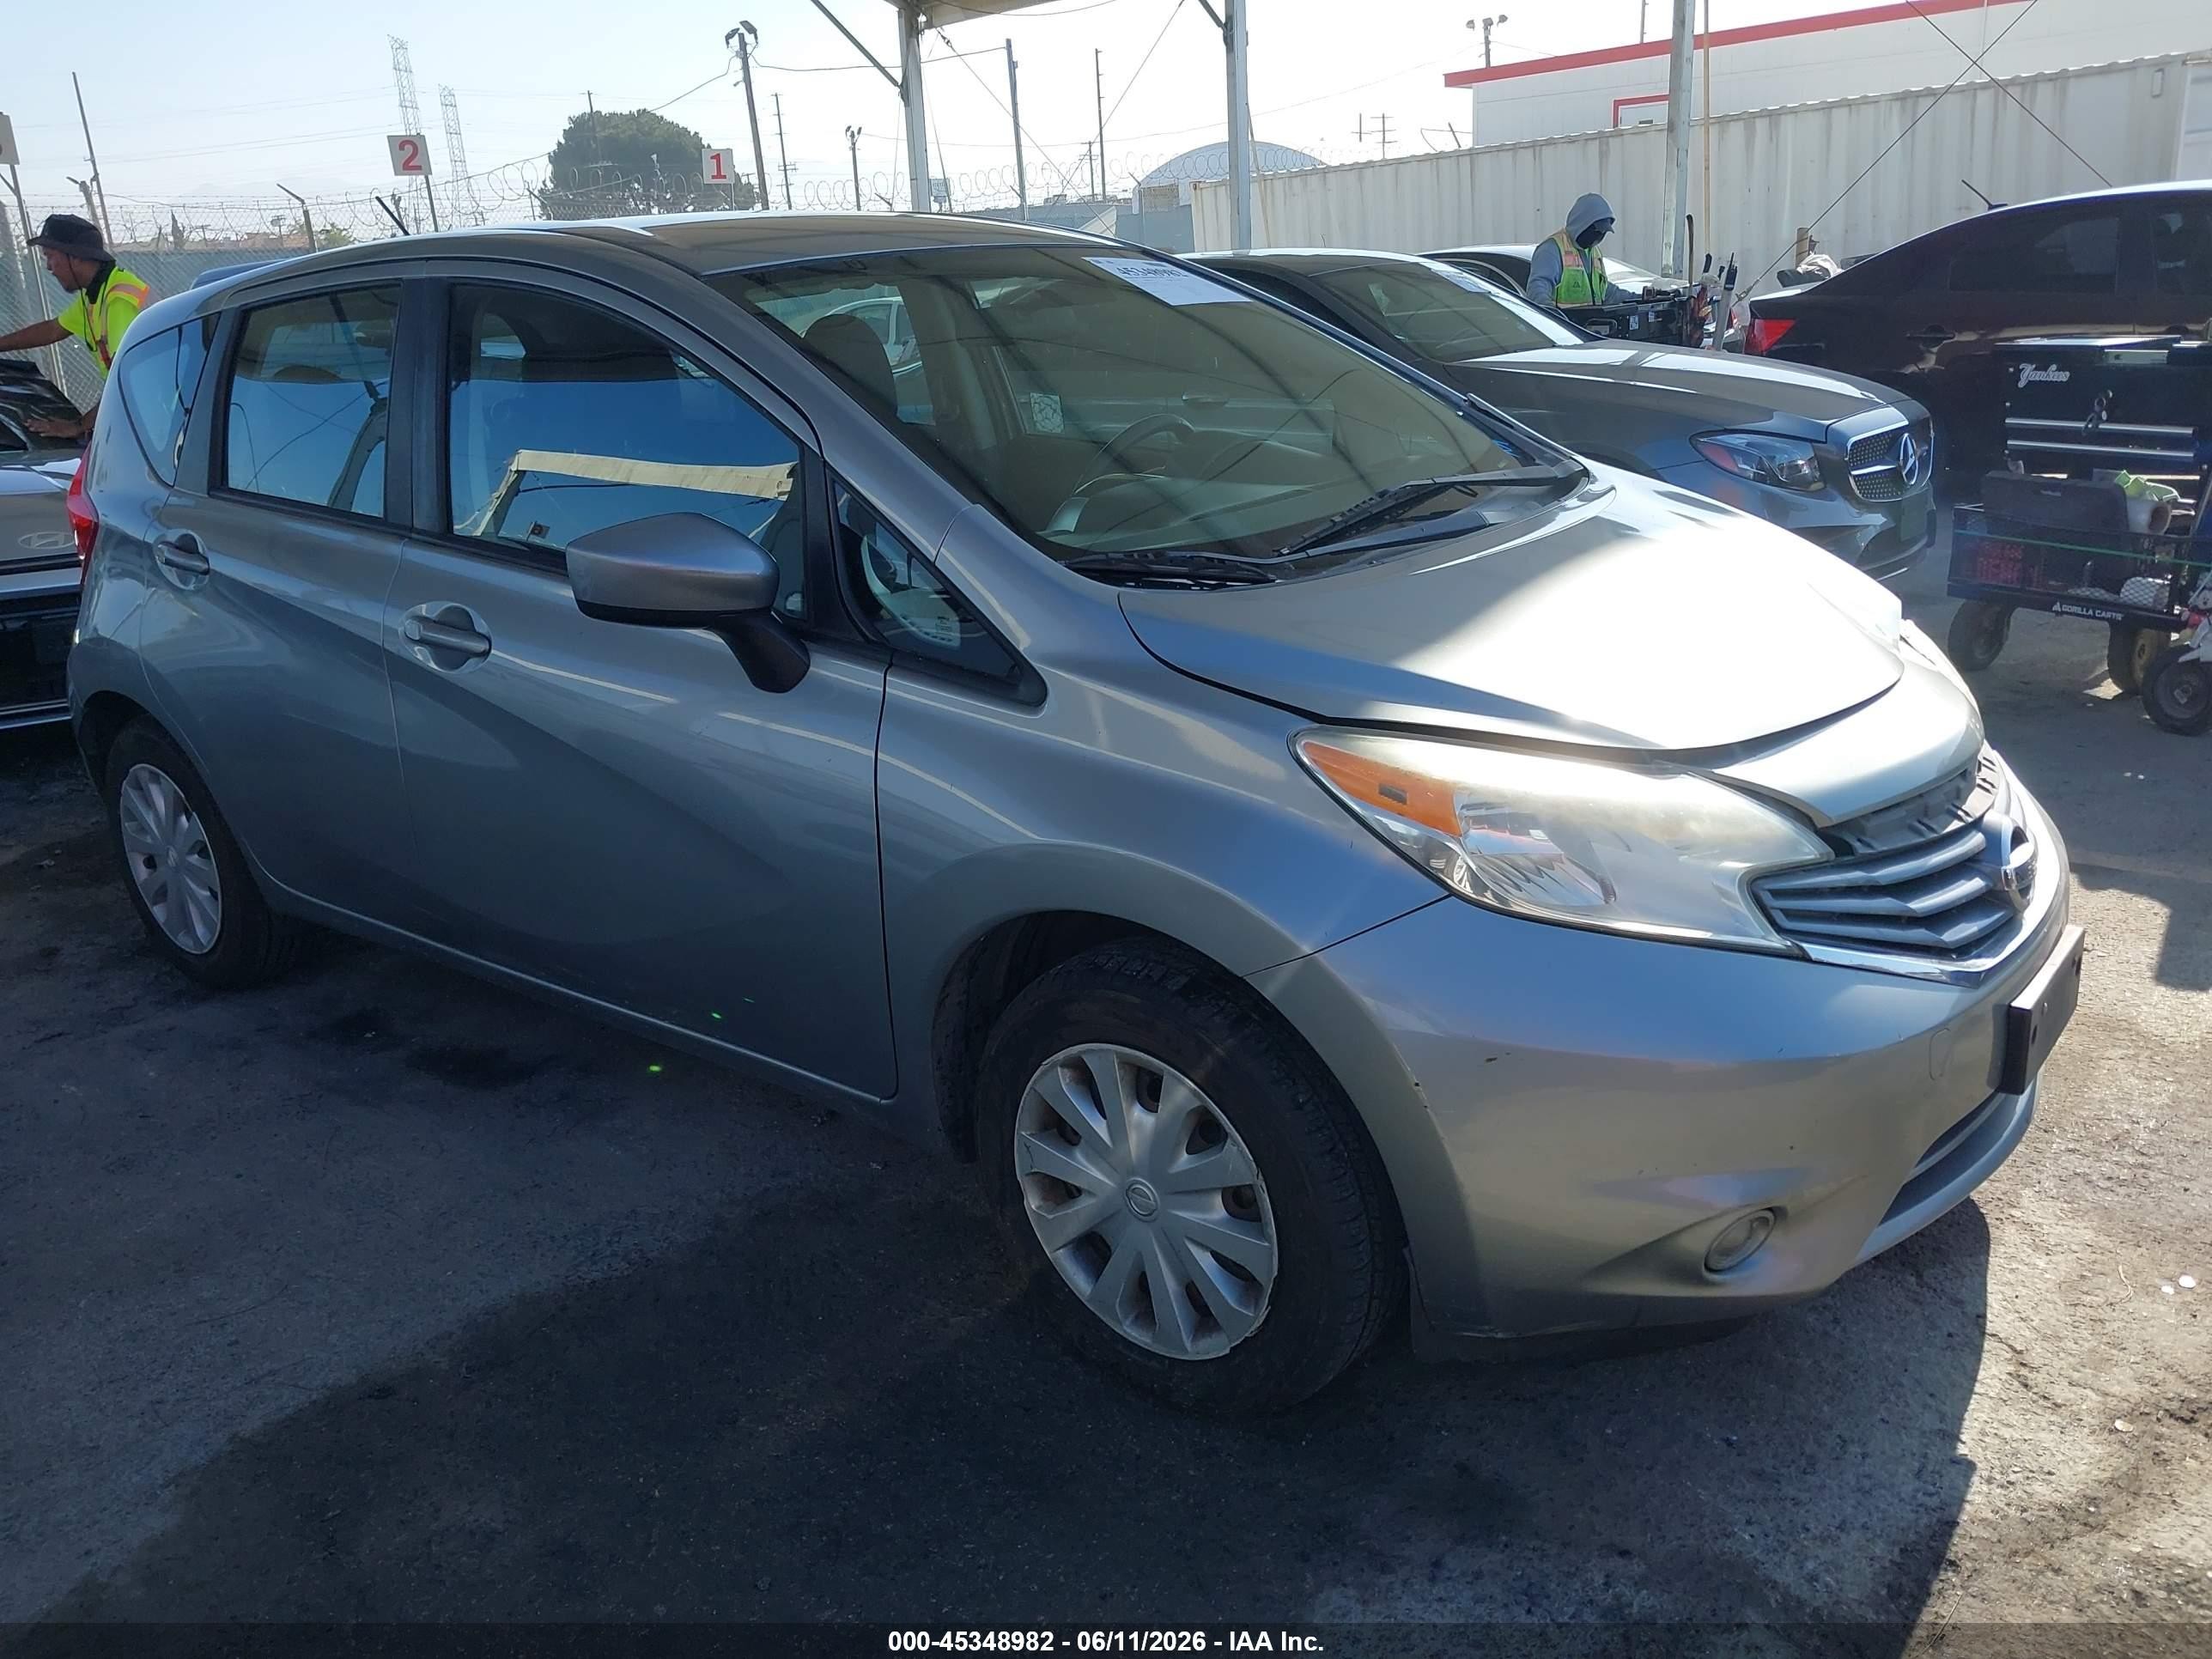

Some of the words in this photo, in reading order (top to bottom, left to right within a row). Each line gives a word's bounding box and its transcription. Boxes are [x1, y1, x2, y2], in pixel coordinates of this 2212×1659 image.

[398, 140, 422, 171] 2
[710, 153, 726, 179] 1
[2018, 363, 2070, 388] Yankees
[2062, 604, 2094, 616] GORILLA
